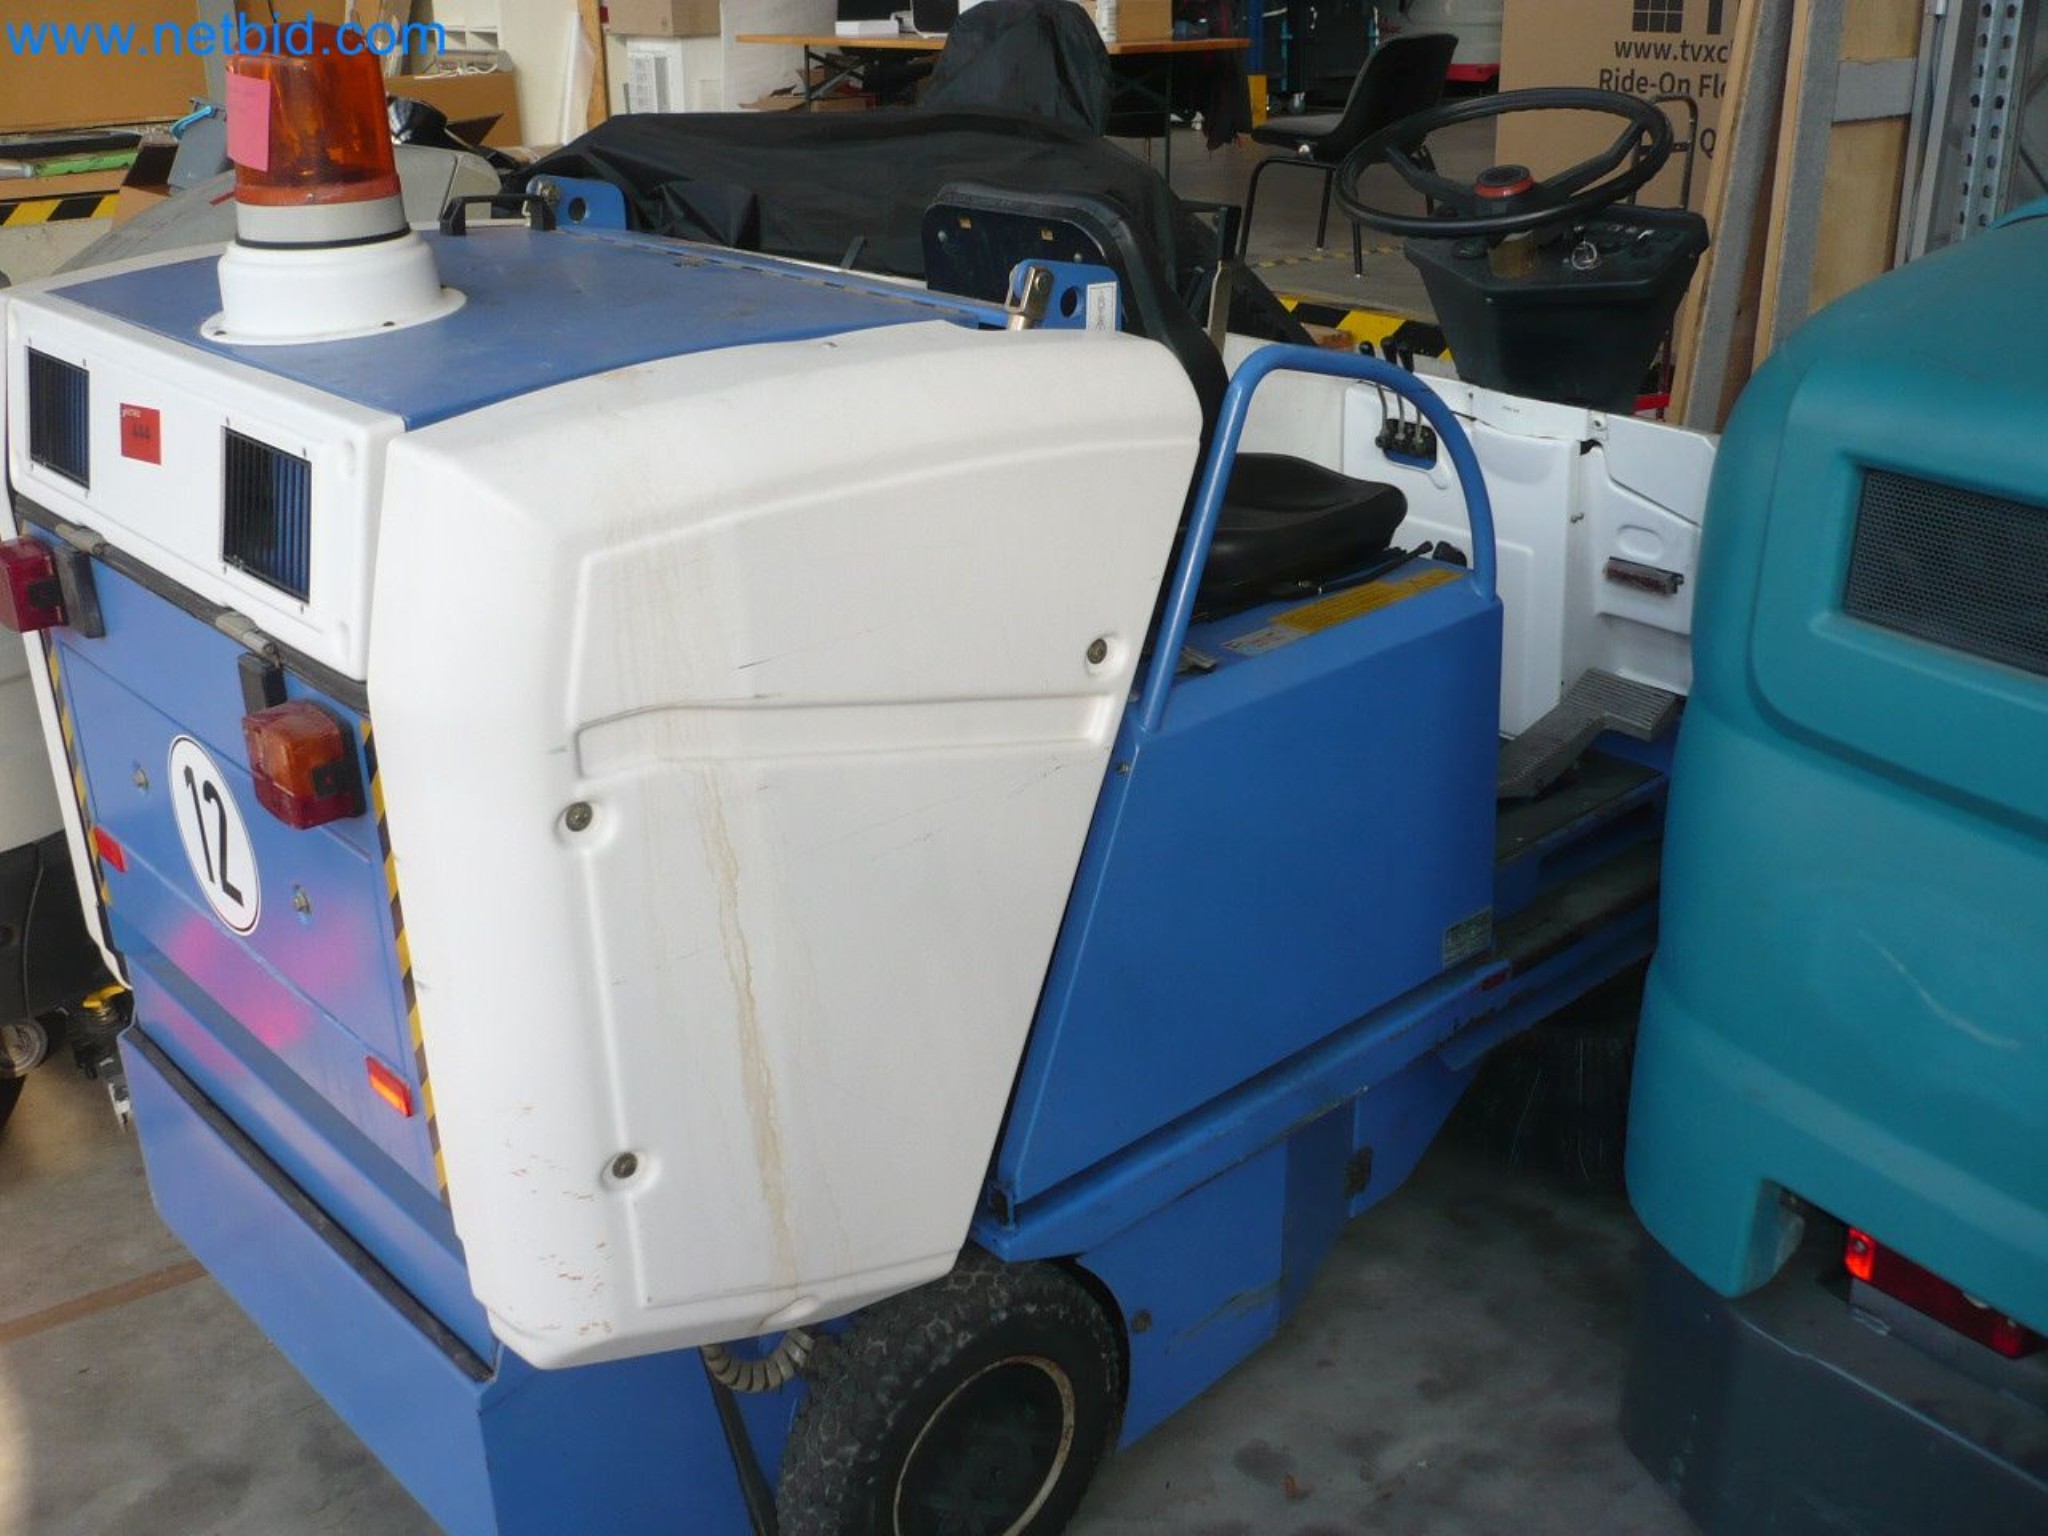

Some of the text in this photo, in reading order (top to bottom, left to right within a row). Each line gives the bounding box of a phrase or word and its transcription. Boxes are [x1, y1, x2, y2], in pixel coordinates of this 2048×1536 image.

[1614, 39, 1734, 64] www.tvxc
[1600, 68, 1691, 95] Ride-On
[184, 765, 244, 907] 12
